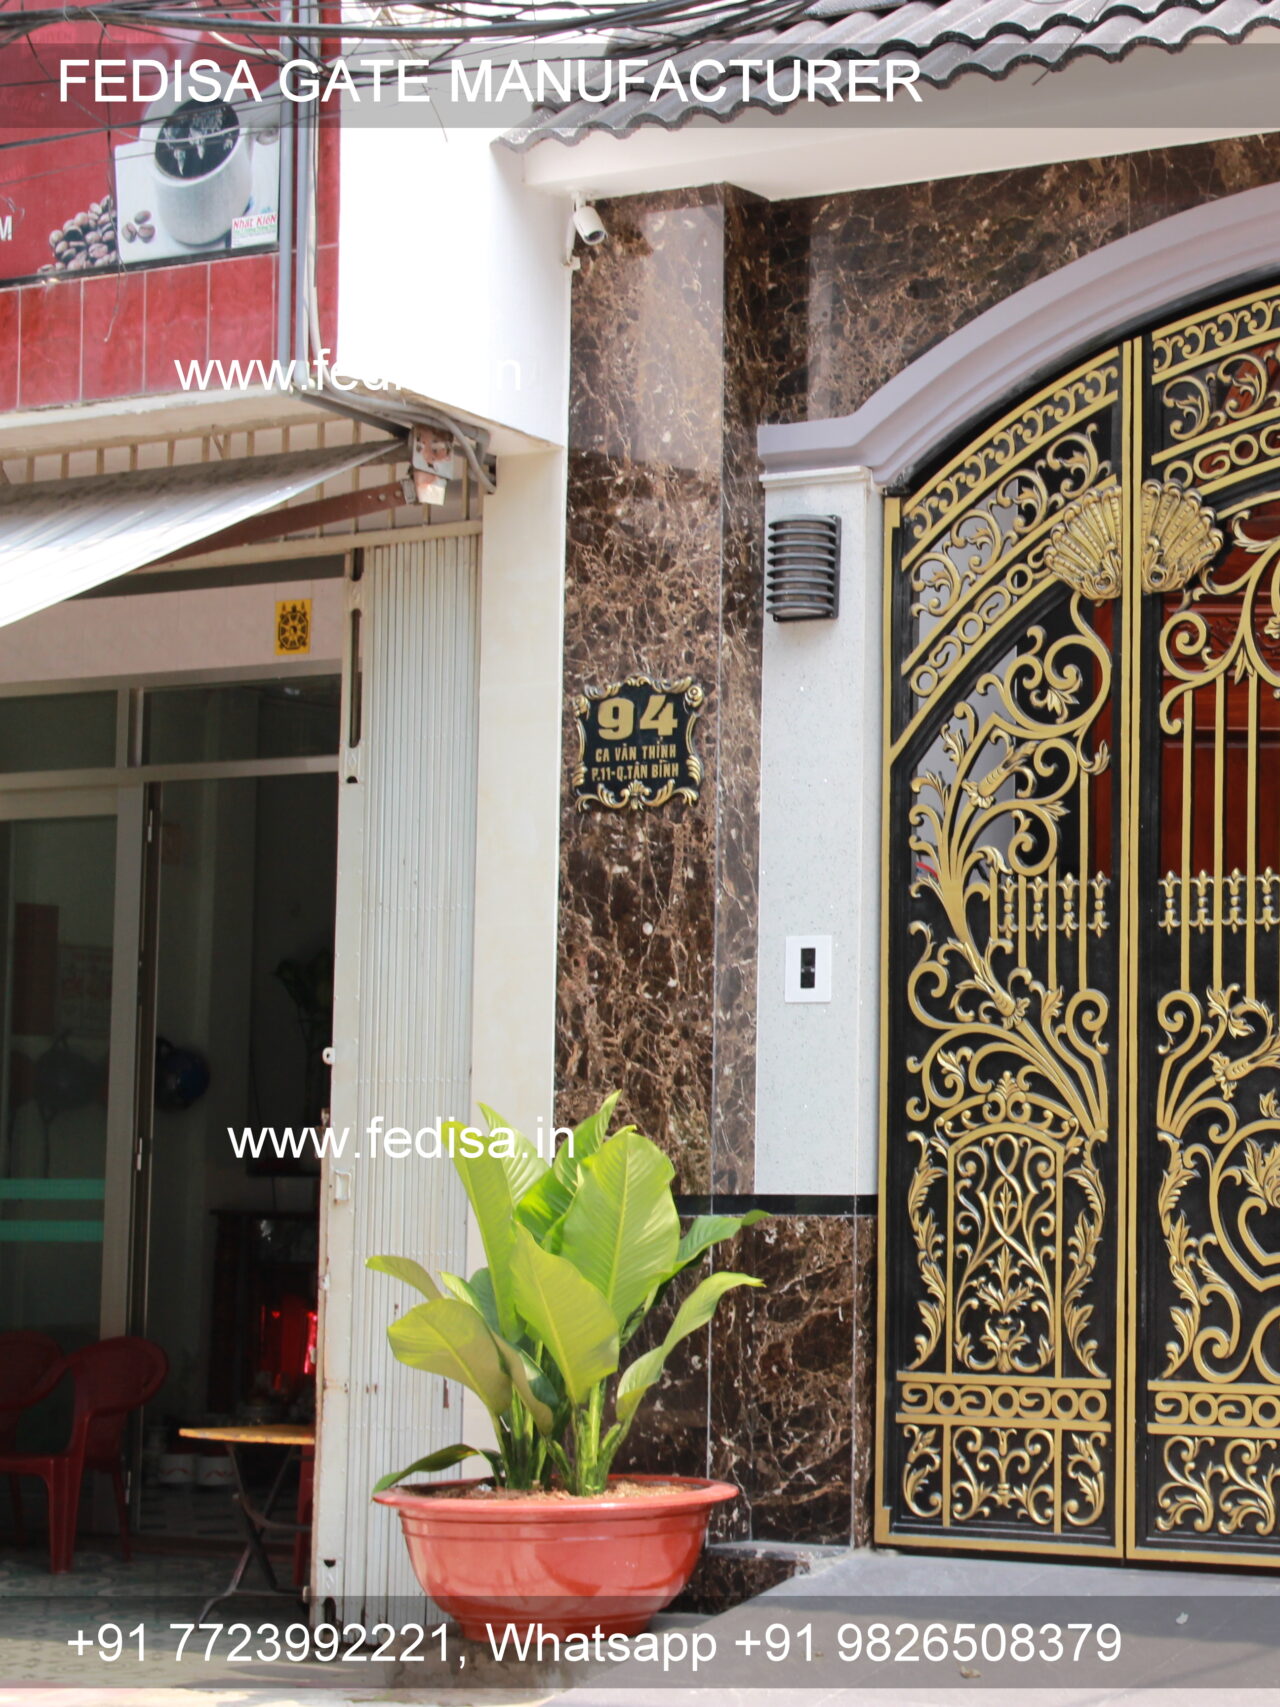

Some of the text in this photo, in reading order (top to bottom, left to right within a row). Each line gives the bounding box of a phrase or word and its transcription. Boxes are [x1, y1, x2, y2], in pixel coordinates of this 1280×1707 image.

[597, 694, 678, 741] 94
[595, 747, 610, 763] CA
[651, 759, 679, 778] BÌNH
